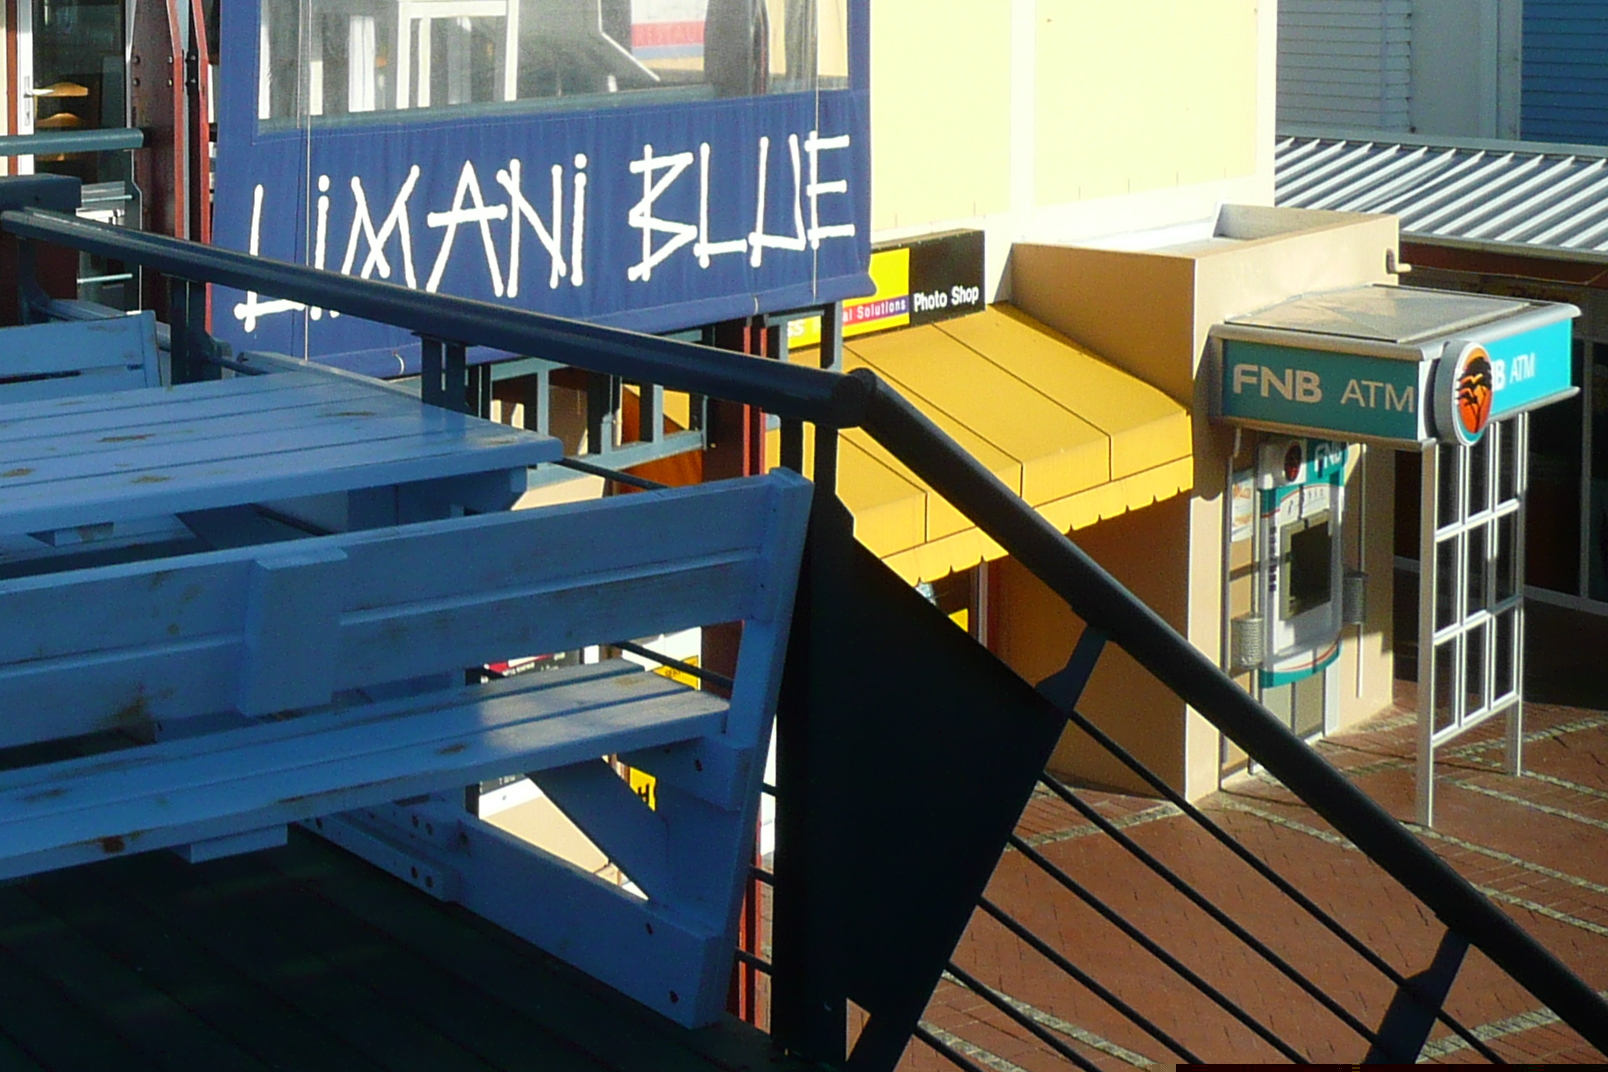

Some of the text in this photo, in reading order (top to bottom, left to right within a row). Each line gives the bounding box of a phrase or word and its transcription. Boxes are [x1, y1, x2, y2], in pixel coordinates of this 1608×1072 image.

[627, 130, 856, 282] BLUE
[857, 299, 906, 321] Solutions
[913, 285, 979, 313] Photo Shop
[1509, 351, 1536, 384] ATM
[1233, 363, 1415, 414] FNB ATM
